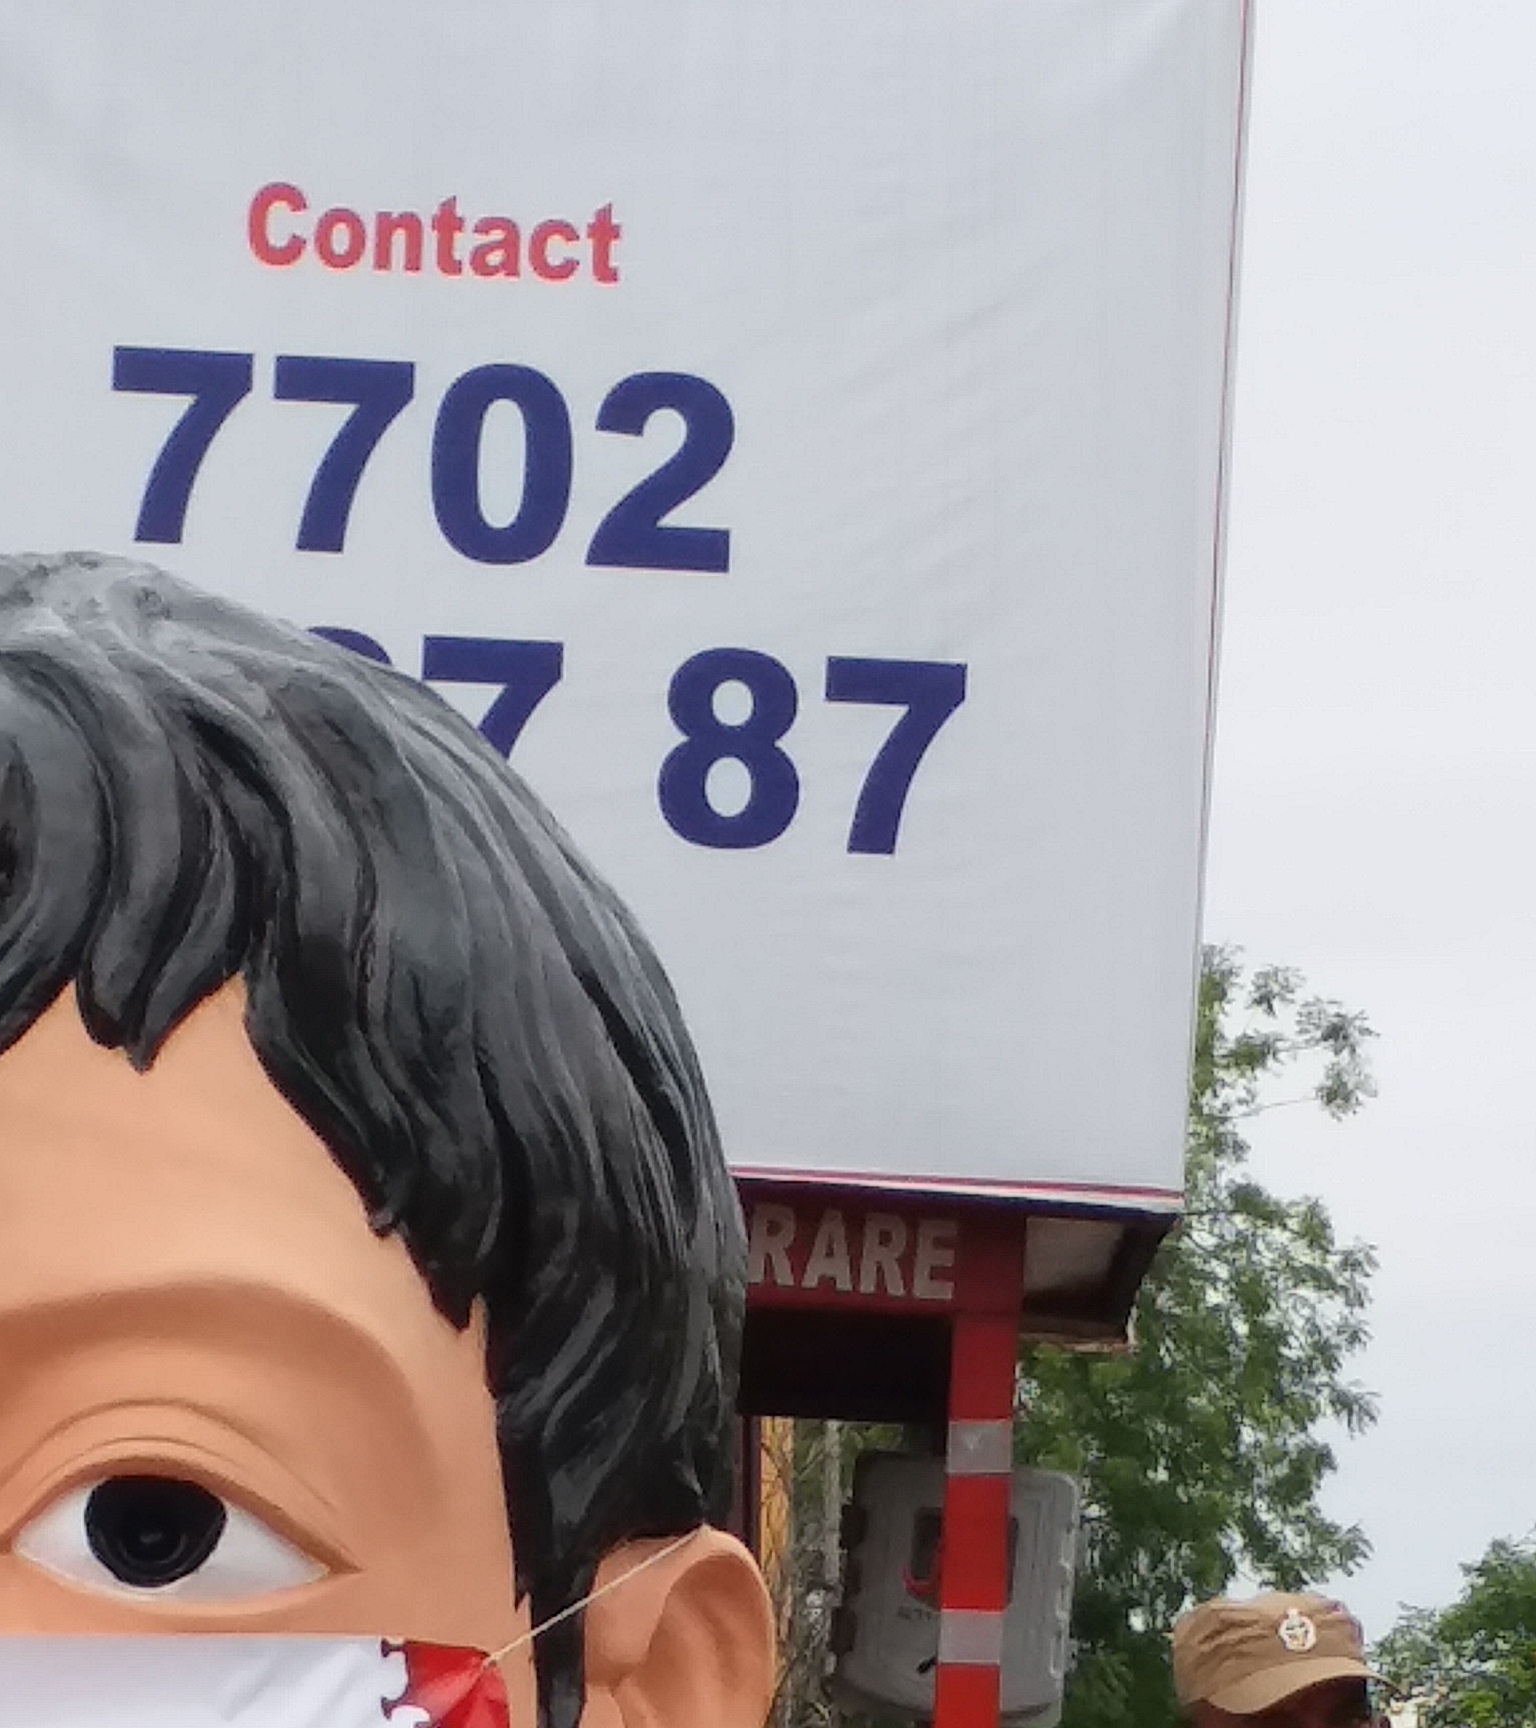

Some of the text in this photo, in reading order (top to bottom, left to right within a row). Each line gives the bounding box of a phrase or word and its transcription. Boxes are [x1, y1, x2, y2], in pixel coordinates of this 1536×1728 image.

[247, 183, 622, 287] Contact
[111, 345, 736, 575] 7702
[309, 626, 968, 856] 7 87
[748, 1205, 958, 1300] RARE
